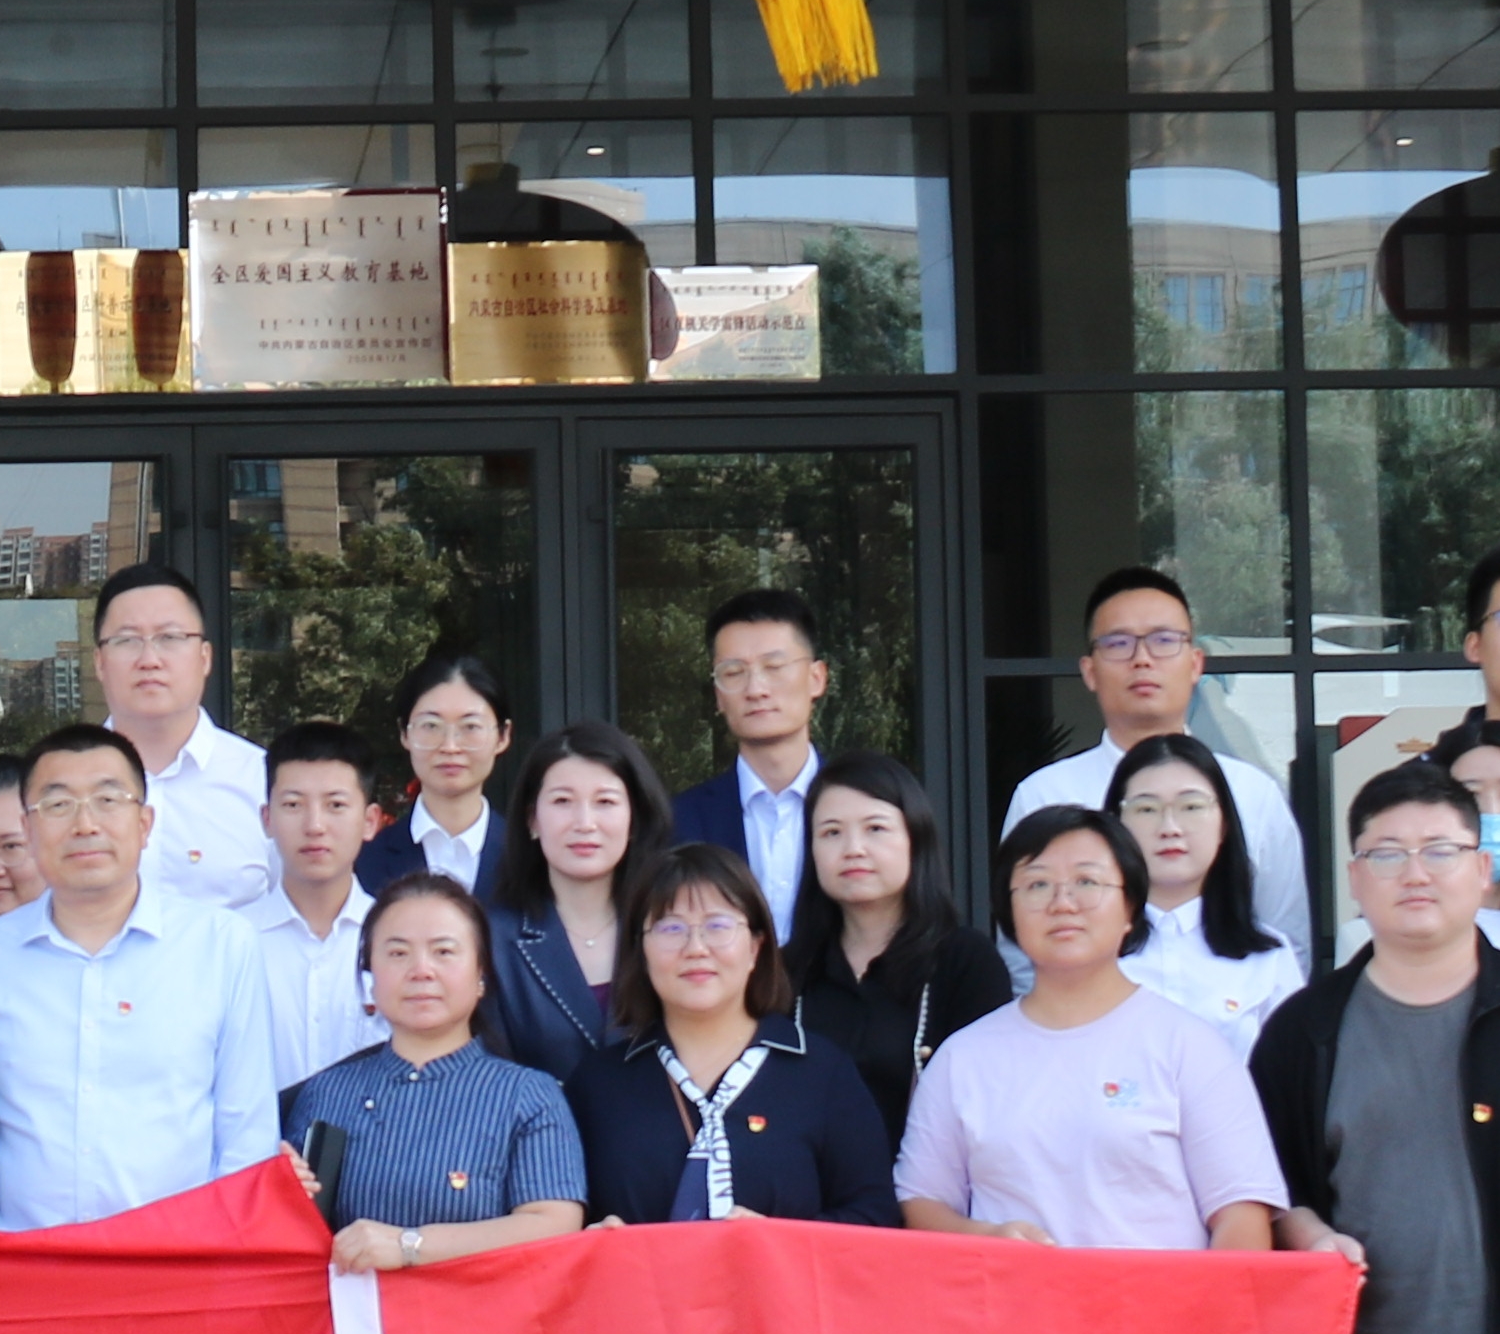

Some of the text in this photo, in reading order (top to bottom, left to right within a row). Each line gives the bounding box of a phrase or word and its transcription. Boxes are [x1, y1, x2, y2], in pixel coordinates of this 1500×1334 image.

[212, 261, 429, 284] 全区爱国主义教育基地
